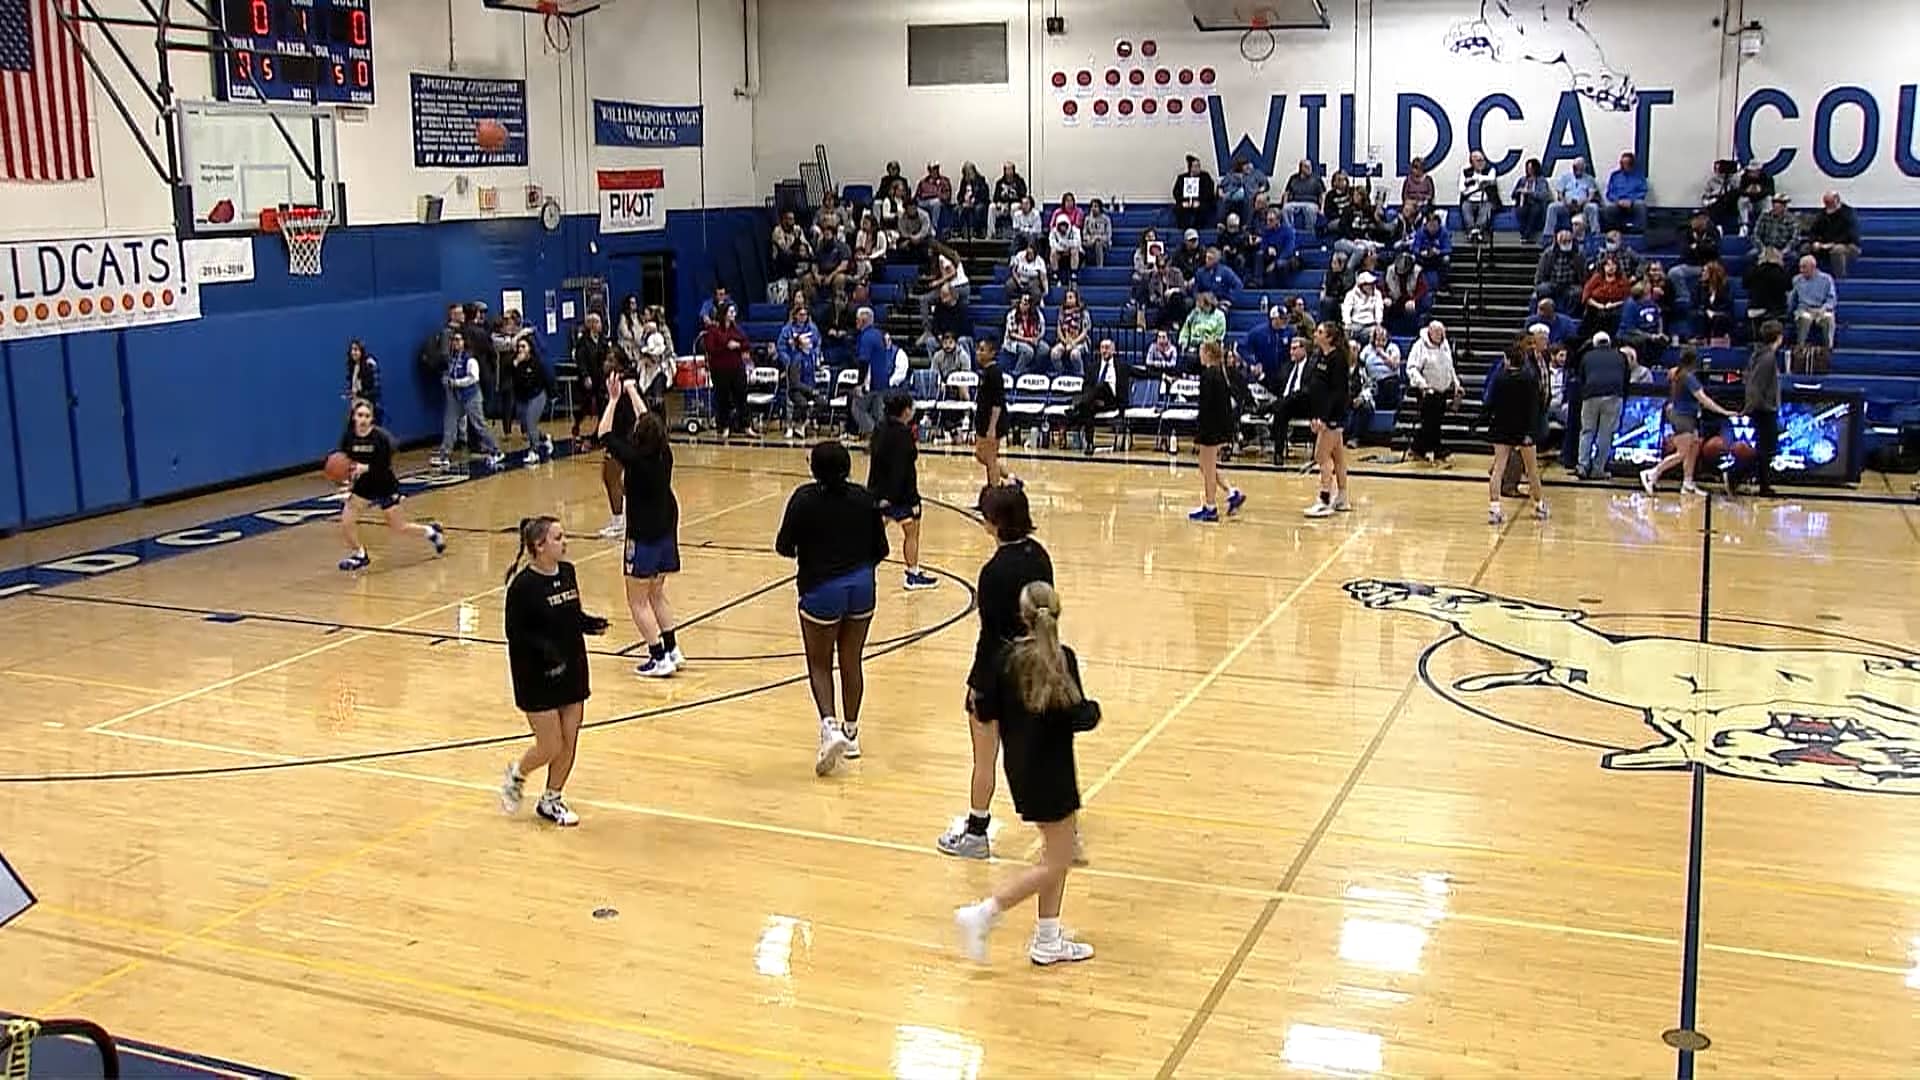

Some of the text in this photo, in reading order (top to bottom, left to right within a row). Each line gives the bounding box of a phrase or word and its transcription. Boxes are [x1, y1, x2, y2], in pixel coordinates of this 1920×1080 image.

[353, 10, 367, 46] 0
[357, 61, 369, 87] 0
[625, 125, 677, 142] WILDCATS
[1206, 89, 1674, 178] WILDCAT
[609, 191, 655, 219] PIVOT
[0, 238, 187, 299] LDCATS!
